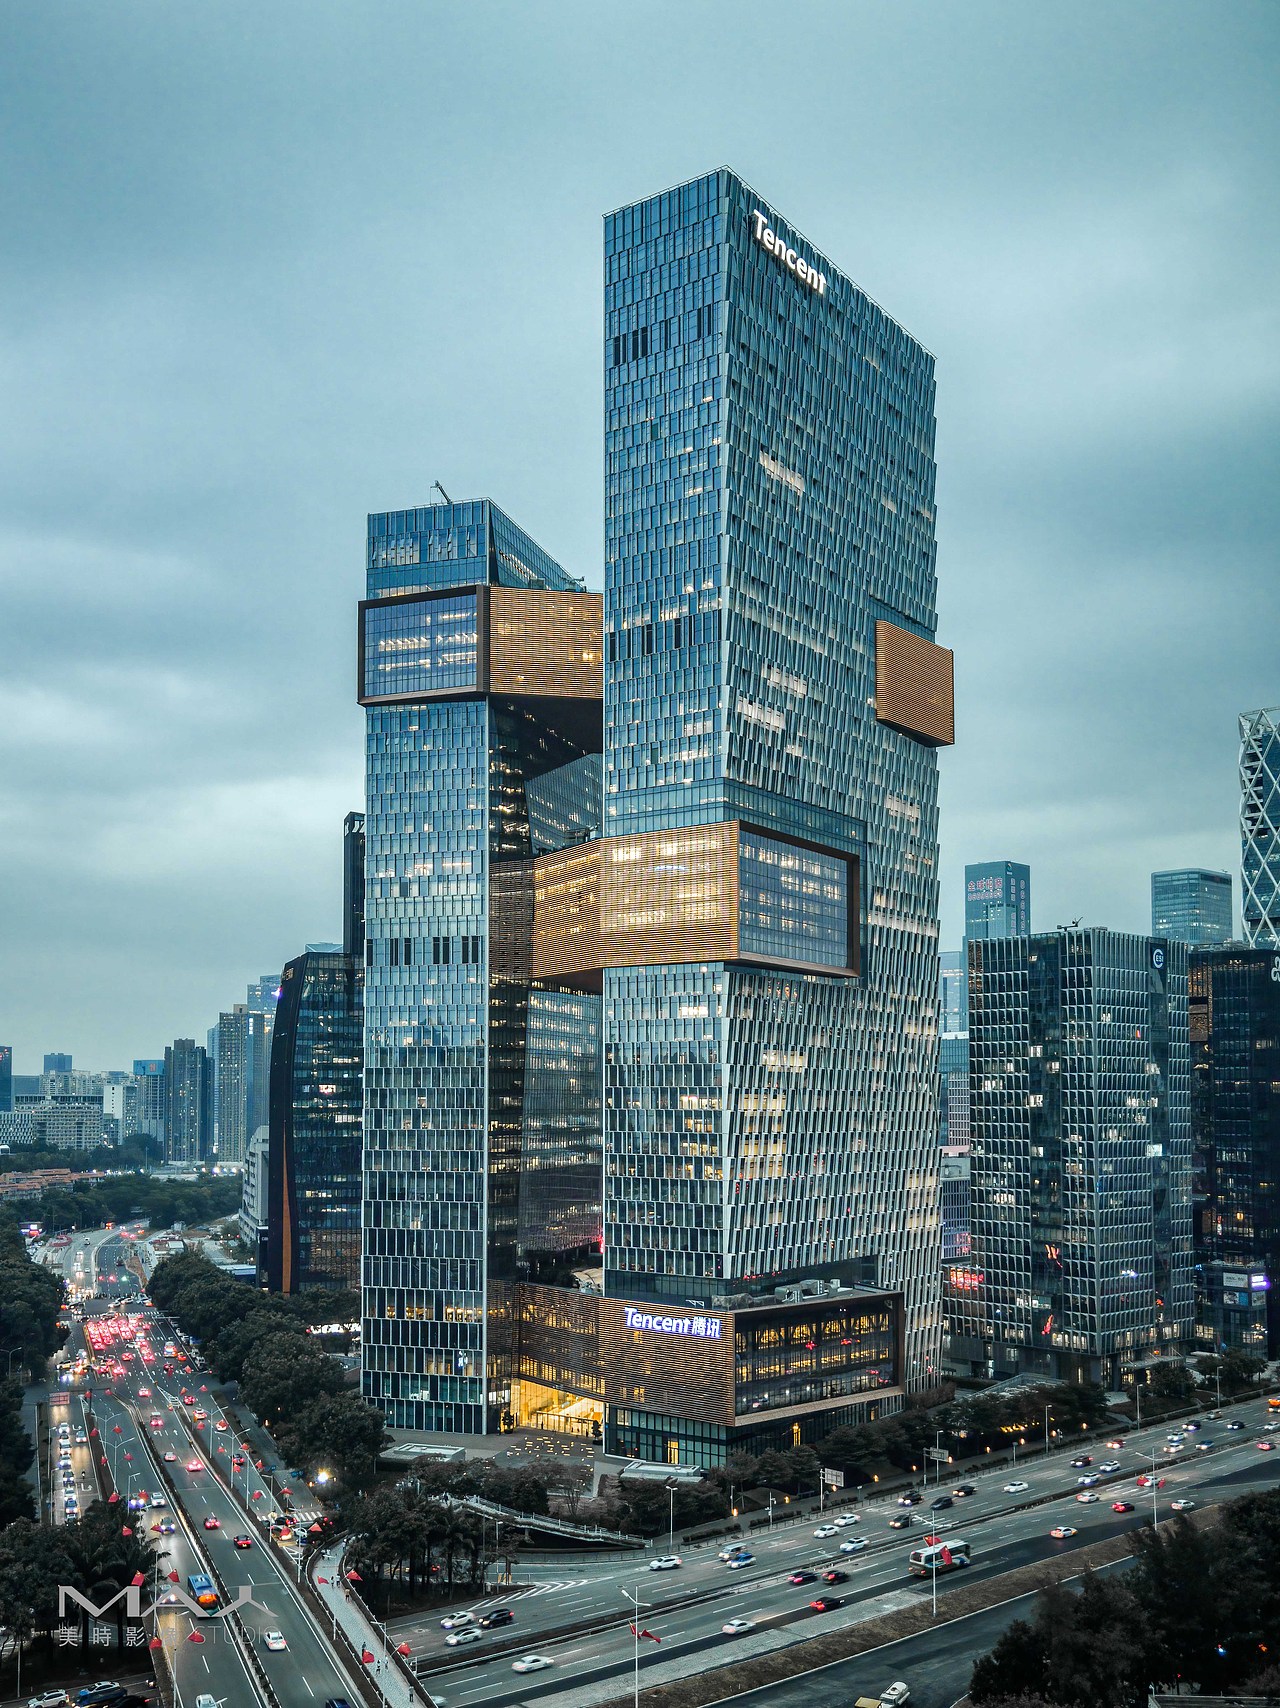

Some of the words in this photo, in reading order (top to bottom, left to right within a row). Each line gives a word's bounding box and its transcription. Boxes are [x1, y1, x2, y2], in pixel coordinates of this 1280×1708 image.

[753, 208, 827, 295] Tencent
[624, 1306, 691, 1334] Tencent
[691, 1316, 721, 1338] 腾讯
